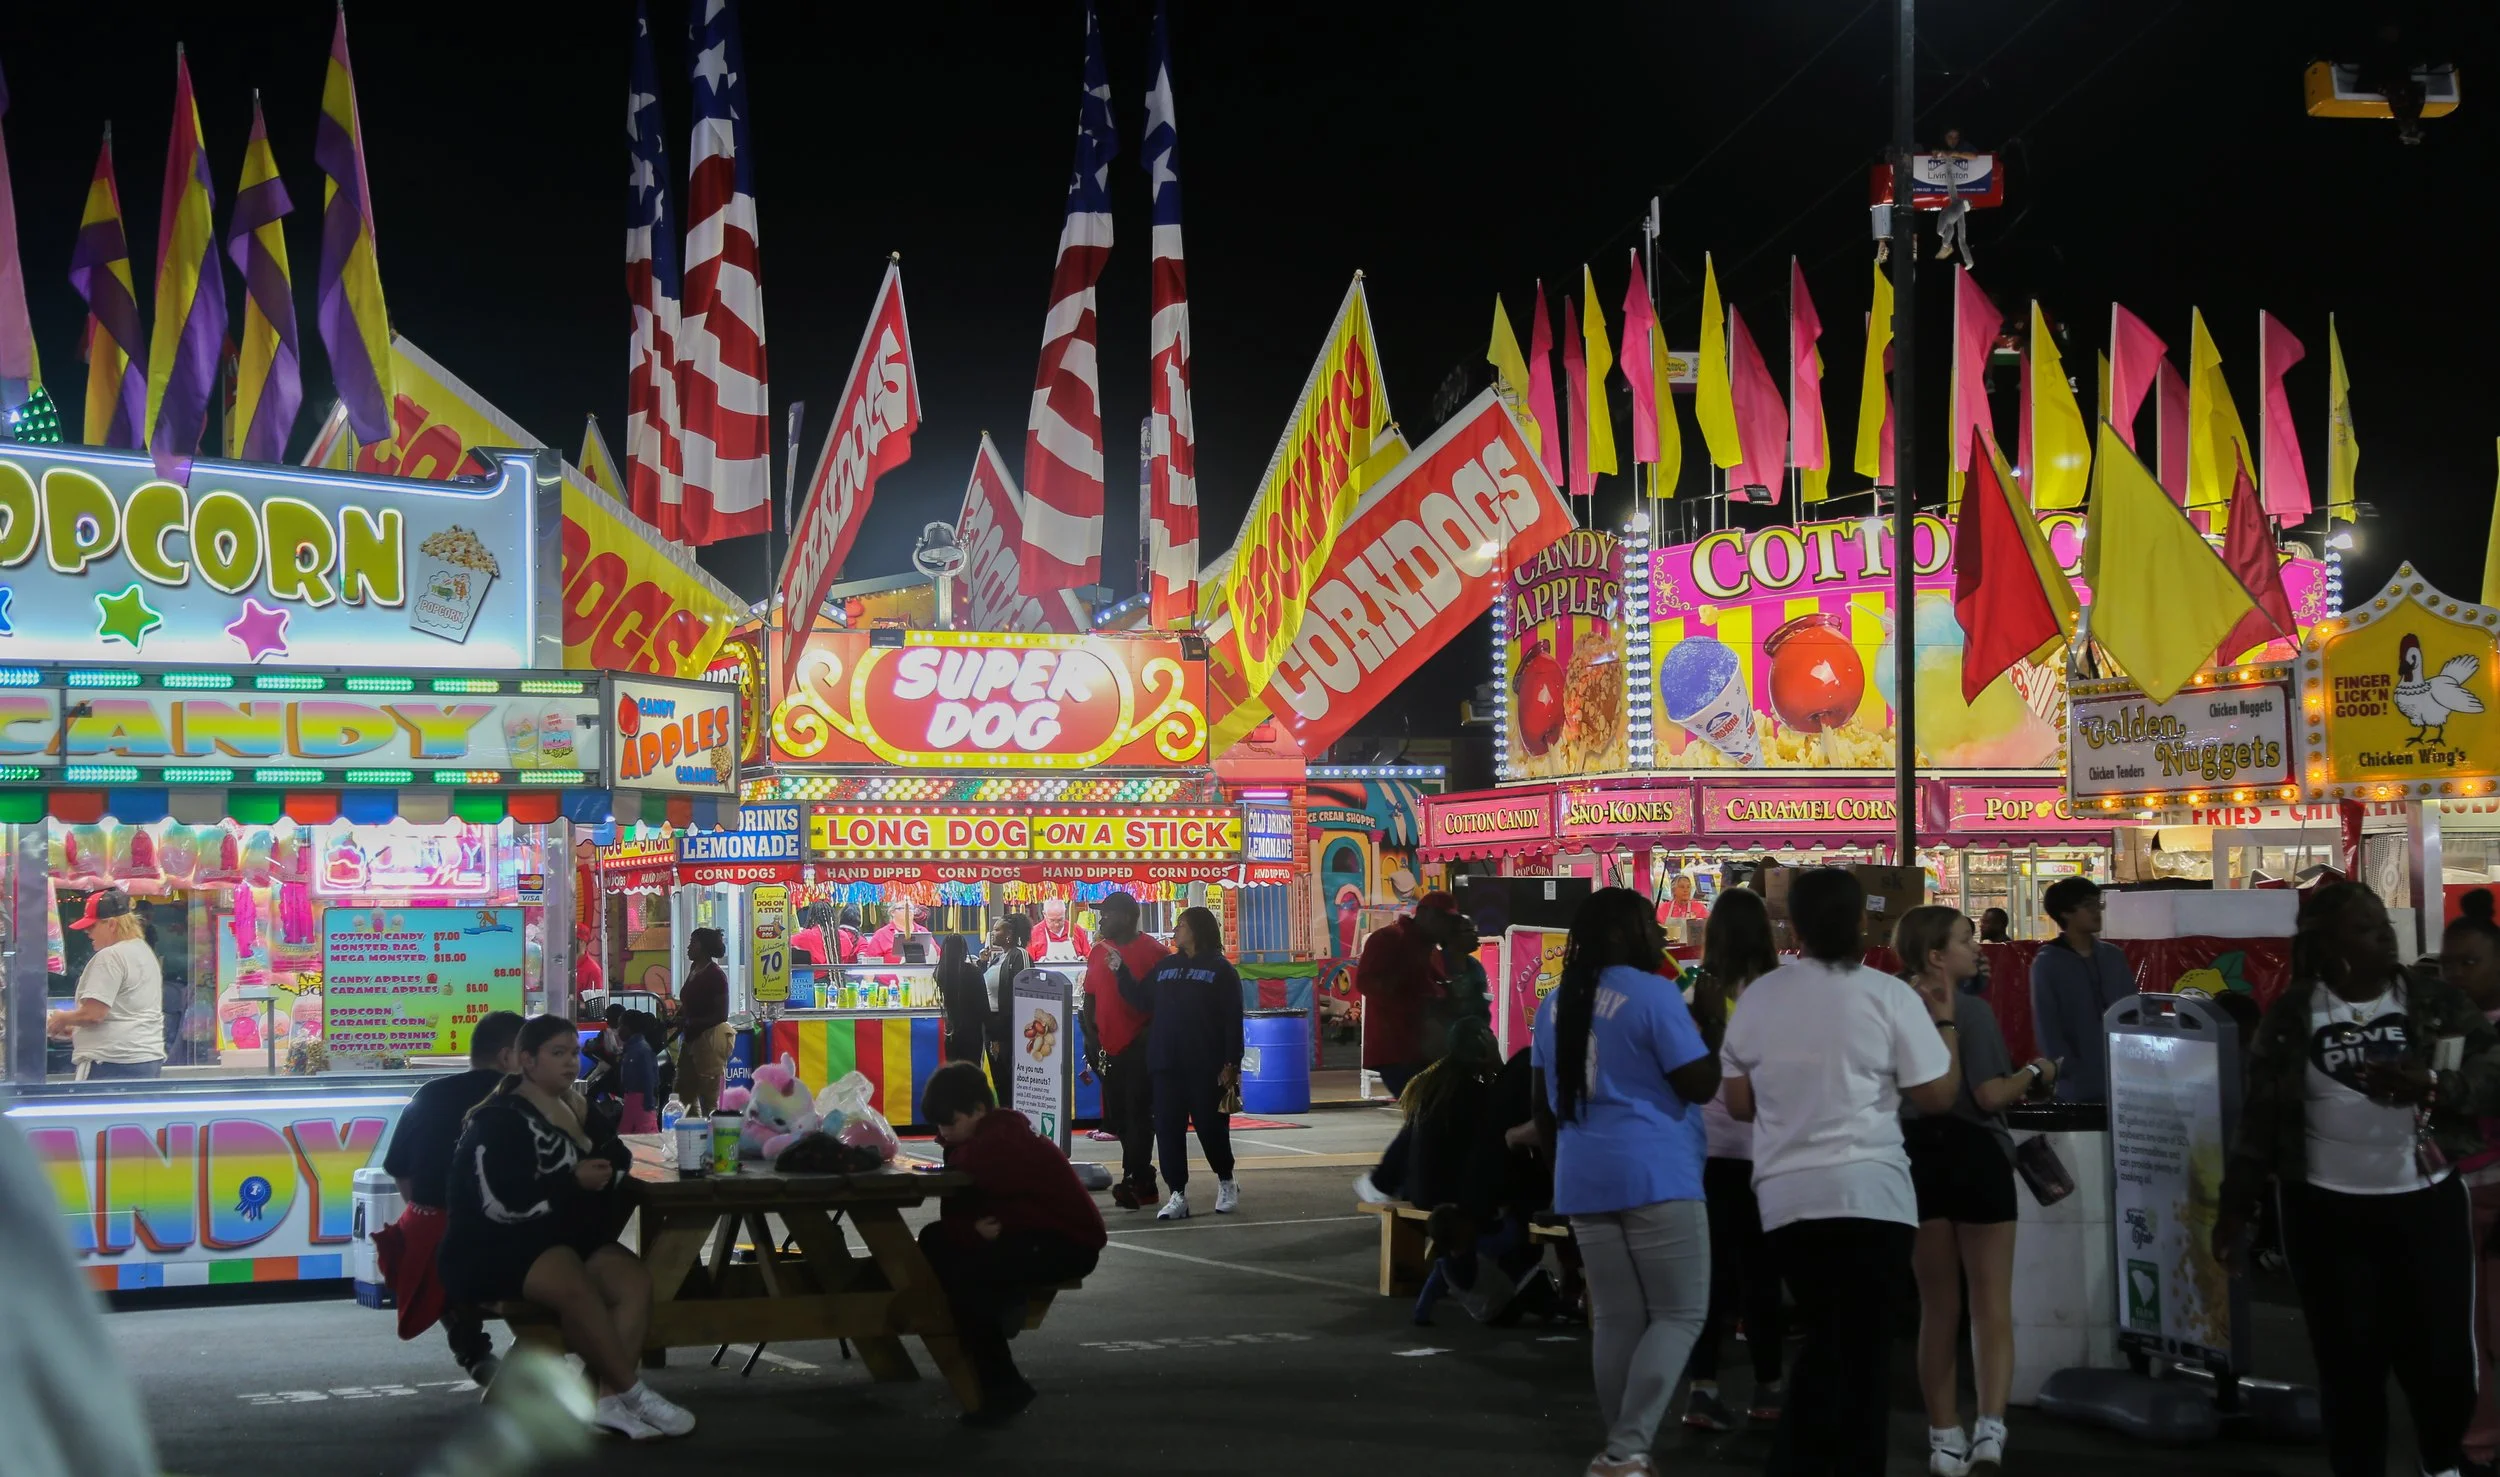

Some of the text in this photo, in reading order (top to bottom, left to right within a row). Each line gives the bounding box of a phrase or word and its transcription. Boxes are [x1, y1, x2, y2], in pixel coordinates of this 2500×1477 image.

[1928, 172, 1968, 180] Livinston
[1513, 529, 1618, 588] CANDY
[1691, 514, 1957, 600] COTTO
[1269, 437, 1541, 721] CORNDOGS
[420, 599, 464, 624] POPCORN
[1513, 575, 1619, 640] APPLES
[893, 647, 1093, 702] SUPER
[2335, 674, 2391, 690] FINGER
[2335, 688, 2389, 703] LICK'N
[638, 697, 676, 719] CANDY
[2209, 698, 2273, 718] Chicken Nuggets
[2335, 703, 2388, 718] GOOD!
[926, 699, 1062, 752] DOG
[2079, 705, 2186, 750] Golden
[620, 706, 730, 781] APPLES
[2154, 735, 2281, 781] Nuggets
[2359, 747, 2467, 767] Chicken Wing's
[2089, 765, 2145, 780] Chicken Tenders
[1307, 810, 1376, 828] CE CREAM SHOPPE
[1570, 799, 1674, 825] SNO-KONES
[1727, 797, 1898, 822] CARAMEL CORN
[1985, 797, 2034, 821] POP
[2192, 801, 2408, 826] FRIES CHIEN
[1248, 812, 1292, 834] COLD DRINKS
[1445, 811, 1496, 835] COTTON
[1497, 808, 1541, 831] CANDY
[828, 820, 1230, 848] LONG DOG ON A STICK
[682, 834, 799, 860] LEMONADE
[1248, 836, 1292, 859] LEMONADE
[694, 867, 776, 880] CORN DOGS
[827, 866, 1230, 879] HAND DIPPED CORN DOGS HAND DIPPED CORN DOGS
[330, 932, 461, 942] COTTON CANDY $7.00
[330, 943, 388, 952] MONSTER
[391, 943, 418, 952] BAG
[330, 954, 365, 962] MEGA
[368, 954, 427, 962] MONSTER
[761, 951, 782, 976] 70
[330, 975, 422, 984] CANDY APPLES
[330, 986, 388, 995] CARAMEL
[391, 986, 439, 994] APPLES
[330, 1007, 392, 1016] POPCORN
[330, 1018, 388, 1027] CARAMEL
[391, 1018, 426, 1026] CORN
[330, 1033, 354, 1041] ICE
[355, 1033, 387, 1041] COLD
[389, 1032, 437, 1040] DRINKS
[330, 1043, 388, 1051] BOTTLED
[388, 1042, 432, 1050] WATER
[2323, 1026, 2407, 1049] LOVE
[1016, 1064, 1025, 1072] Are
[1025, 1066, 1034, 1074] you
[1016, 1074, 1051, 1086] about peanuts?
